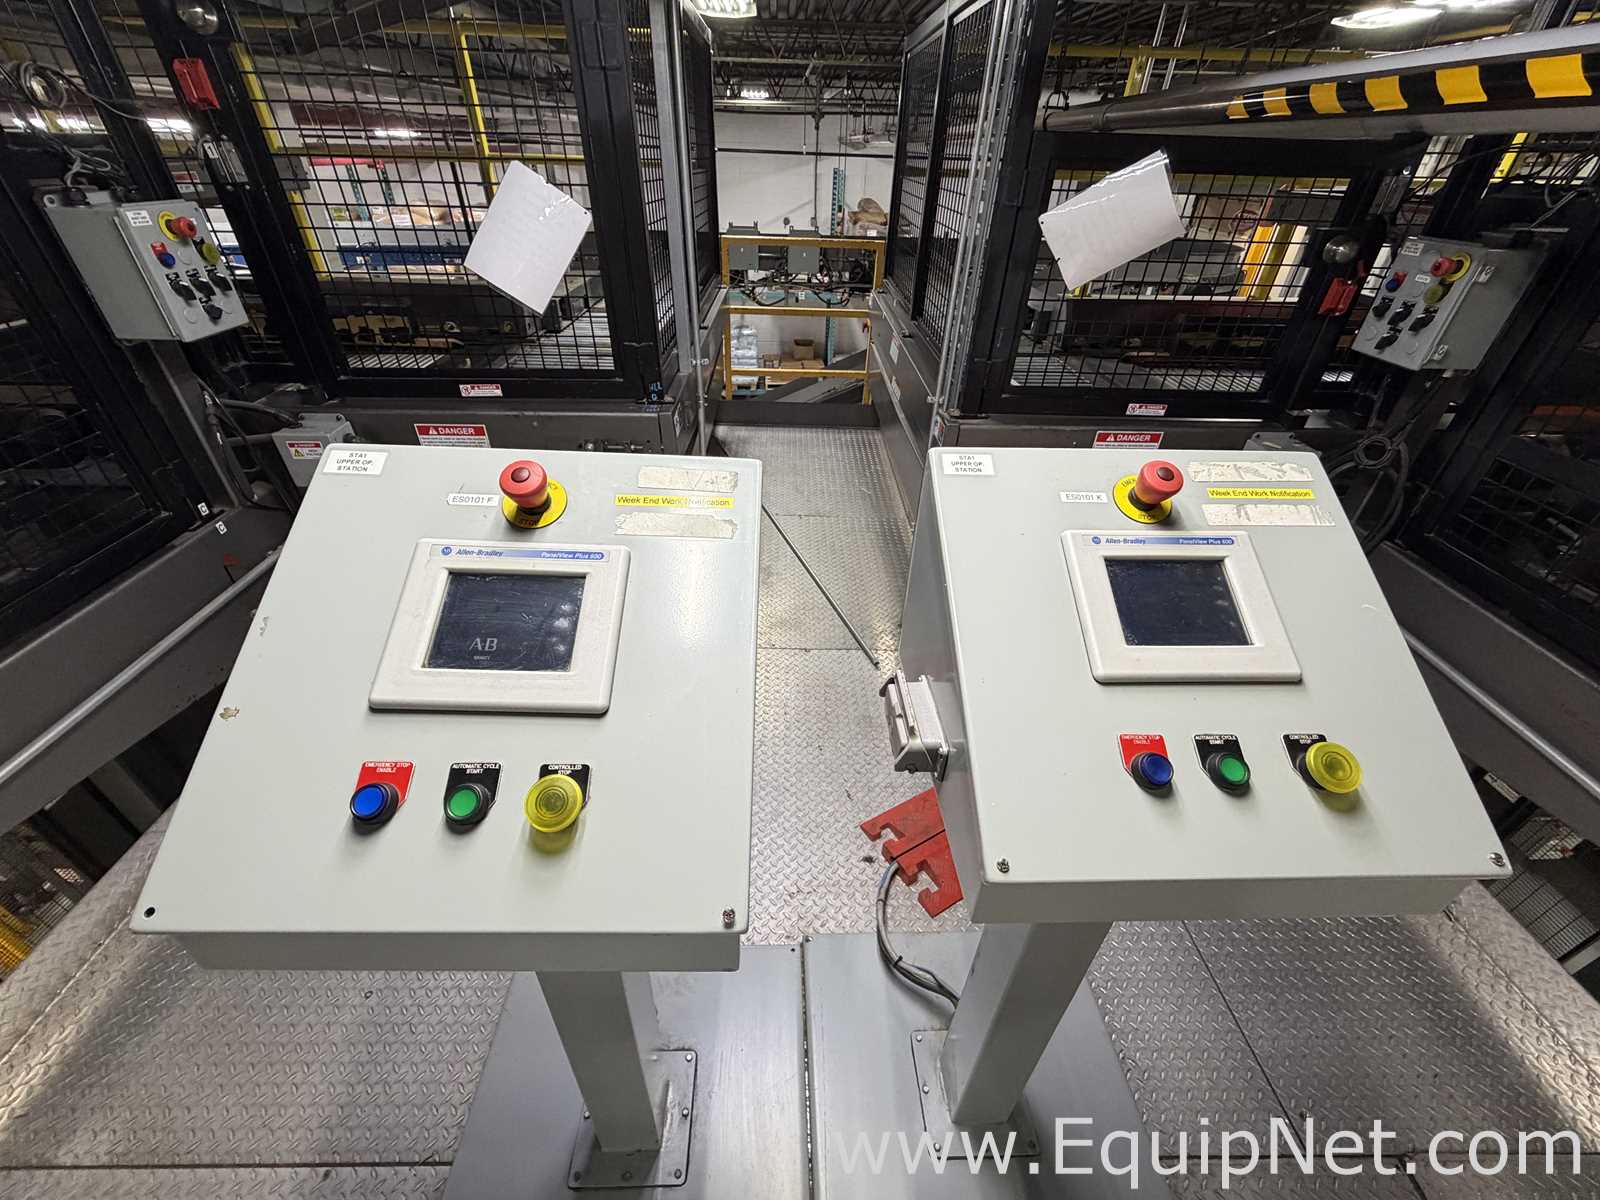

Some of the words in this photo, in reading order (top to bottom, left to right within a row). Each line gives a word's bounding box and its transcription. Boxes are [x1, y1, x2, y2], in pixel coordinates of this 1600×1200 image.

[438, 427, 475, 435] DANGER
[1116, 434, 1151, 442] DANGER
[1208, 489, 1232, 498] Week
[1233, 489, 1249, 497] End
[1249, 490, 1269, 498] Work
[1270, 490, 1311, 498] Notification
[617, 495, 641, 504] Week
[643, 496, 660, 504] End
[1105, 537, 1146, 545] Allen-Bradley
[456, 548, 504, 557] Allen-Bradley
